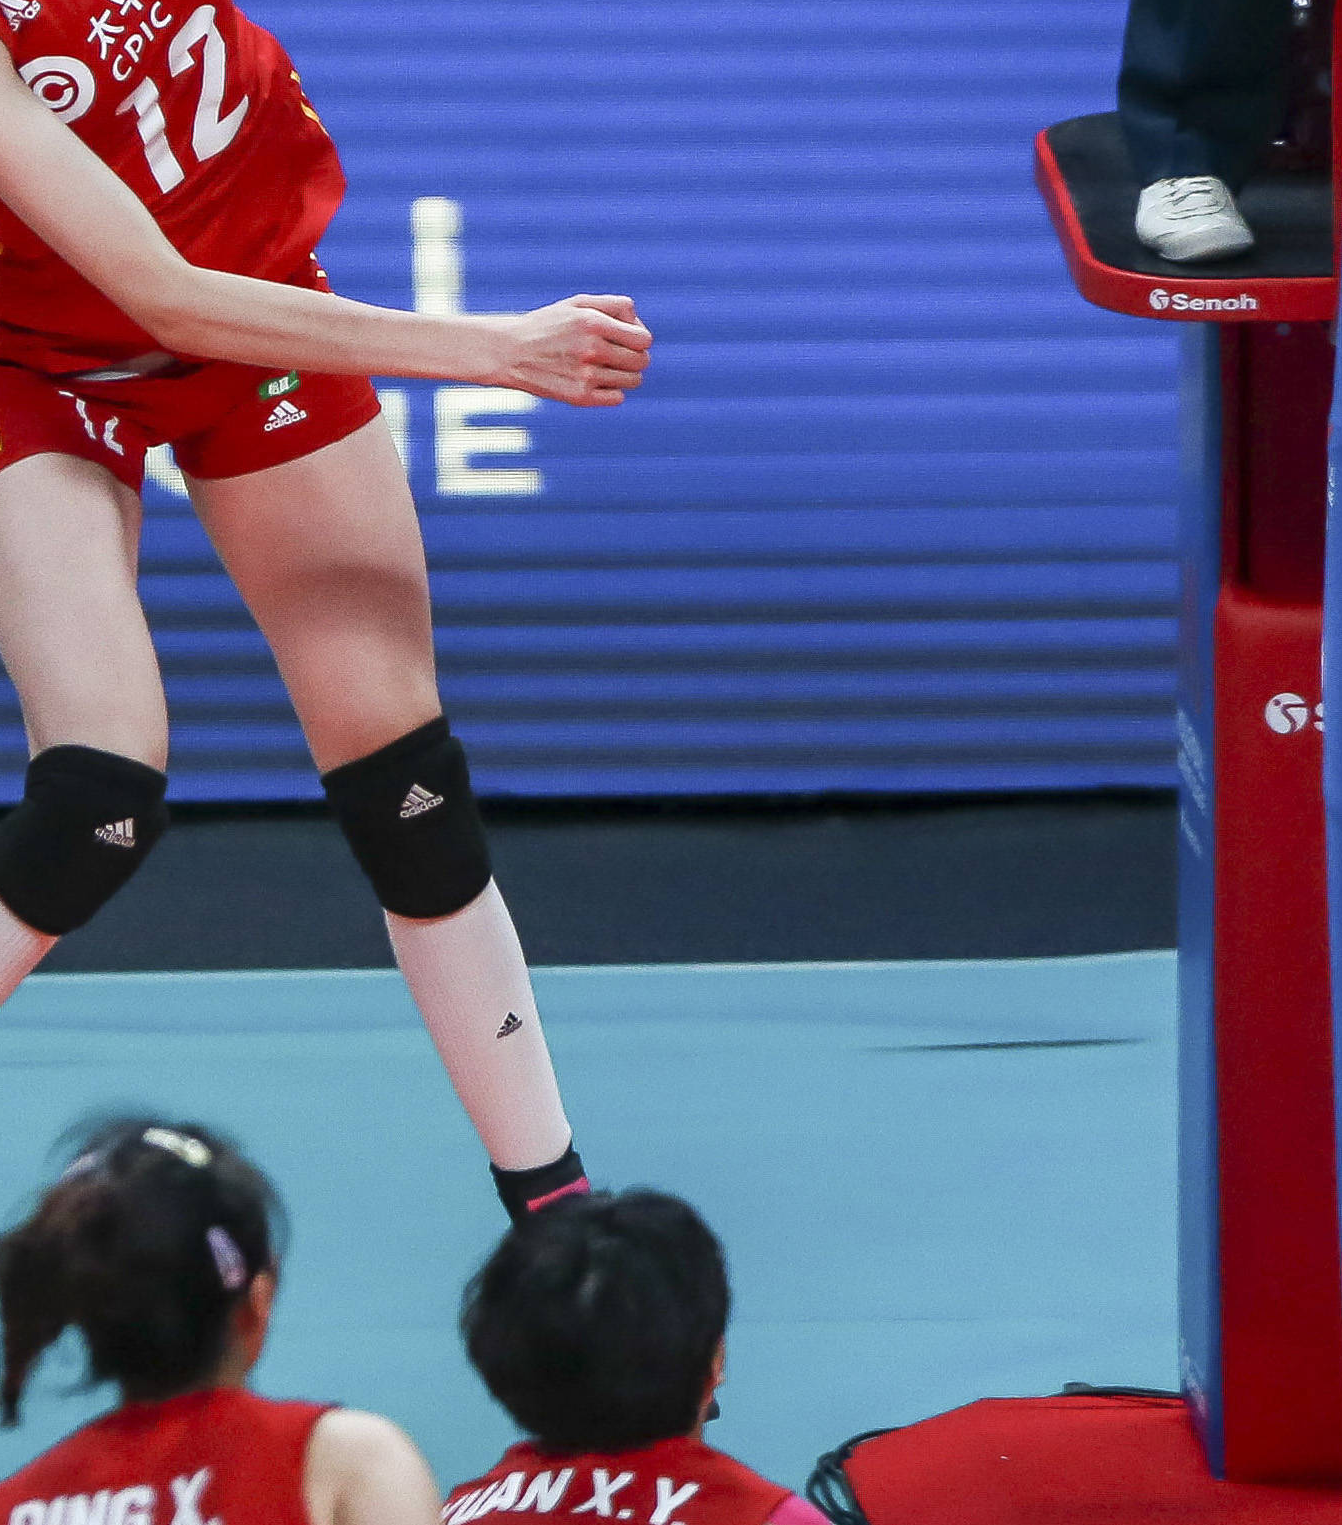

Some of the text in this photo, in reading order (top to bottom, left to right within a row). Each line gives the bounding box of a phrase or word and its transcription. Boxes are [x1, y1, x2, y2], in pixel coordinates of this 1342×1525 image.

[111, 1, 173, 82] CPIC
[115, 4, 249, 194] 12
[1170, 293, 1258, 311] Senoh
[263, 409, 307, 432] adidas
